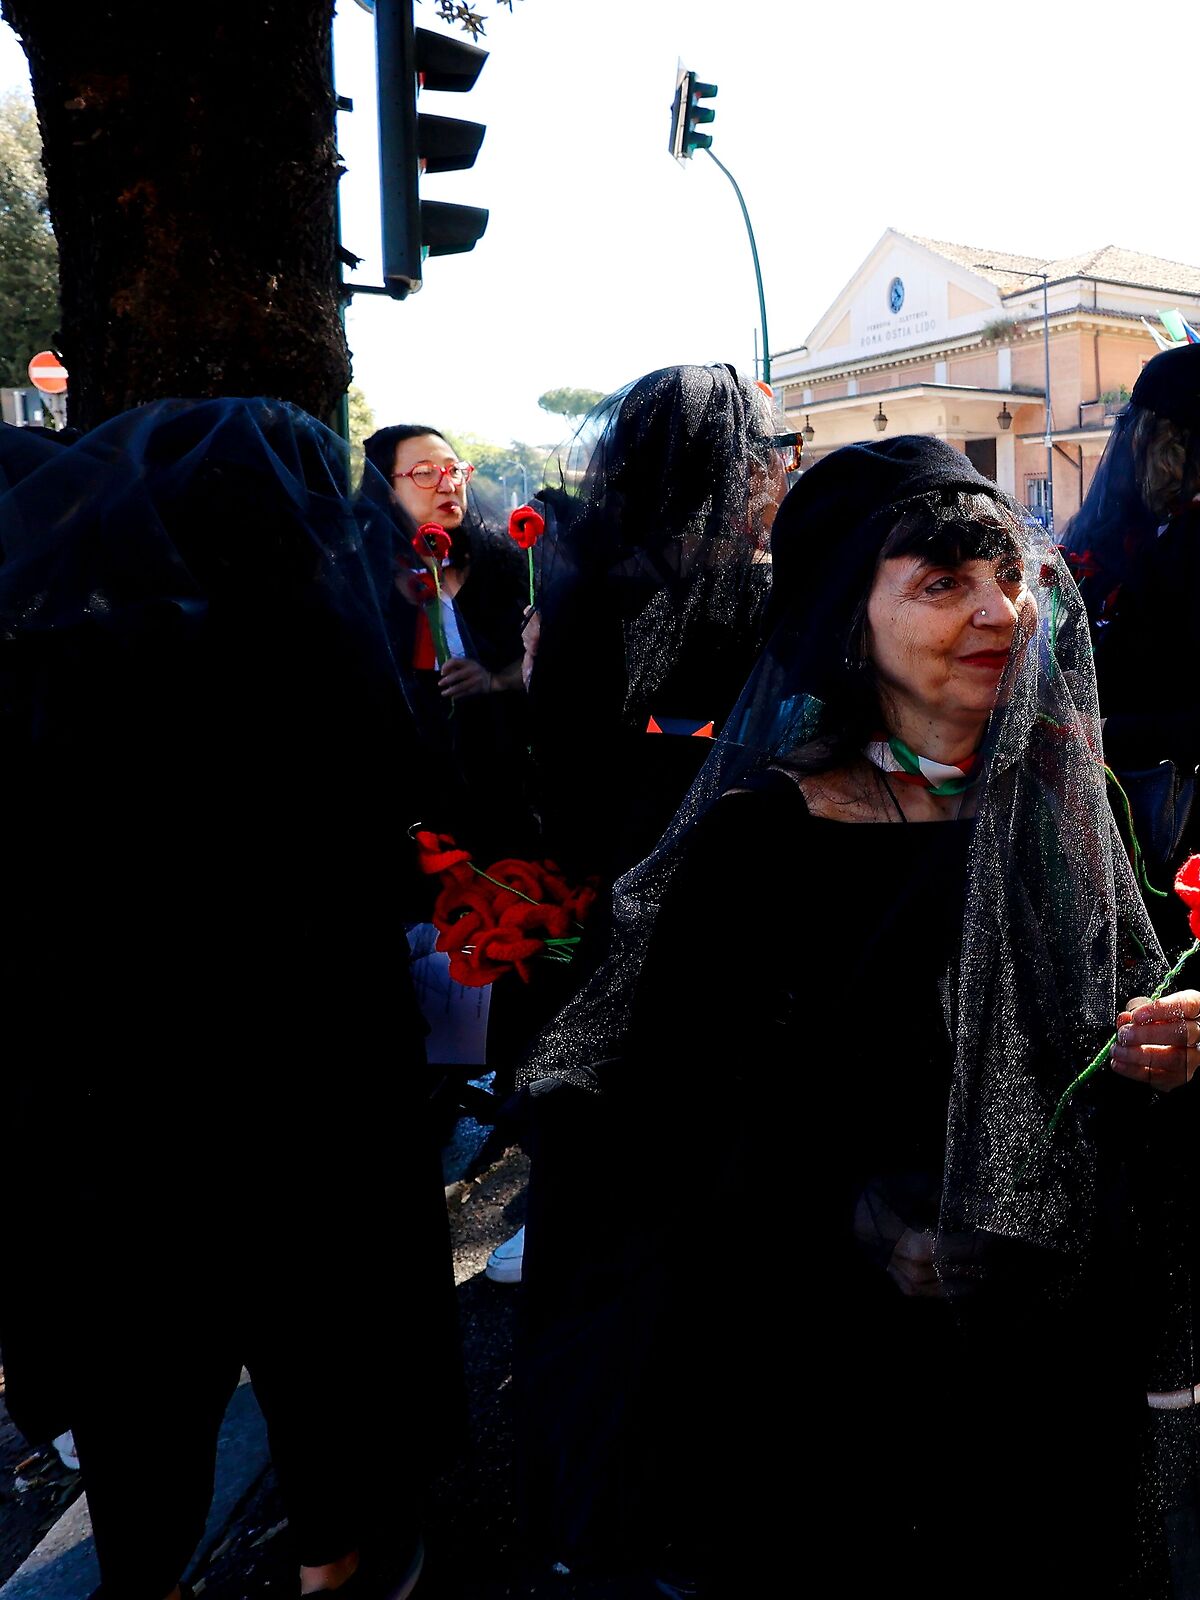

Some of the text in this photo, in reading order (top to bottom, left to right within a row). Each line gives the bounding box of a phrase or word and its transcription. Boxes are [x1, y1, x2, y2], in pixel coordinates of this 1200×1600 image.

[861, 319, 936, 347] ROMA OSTIA LIDO
